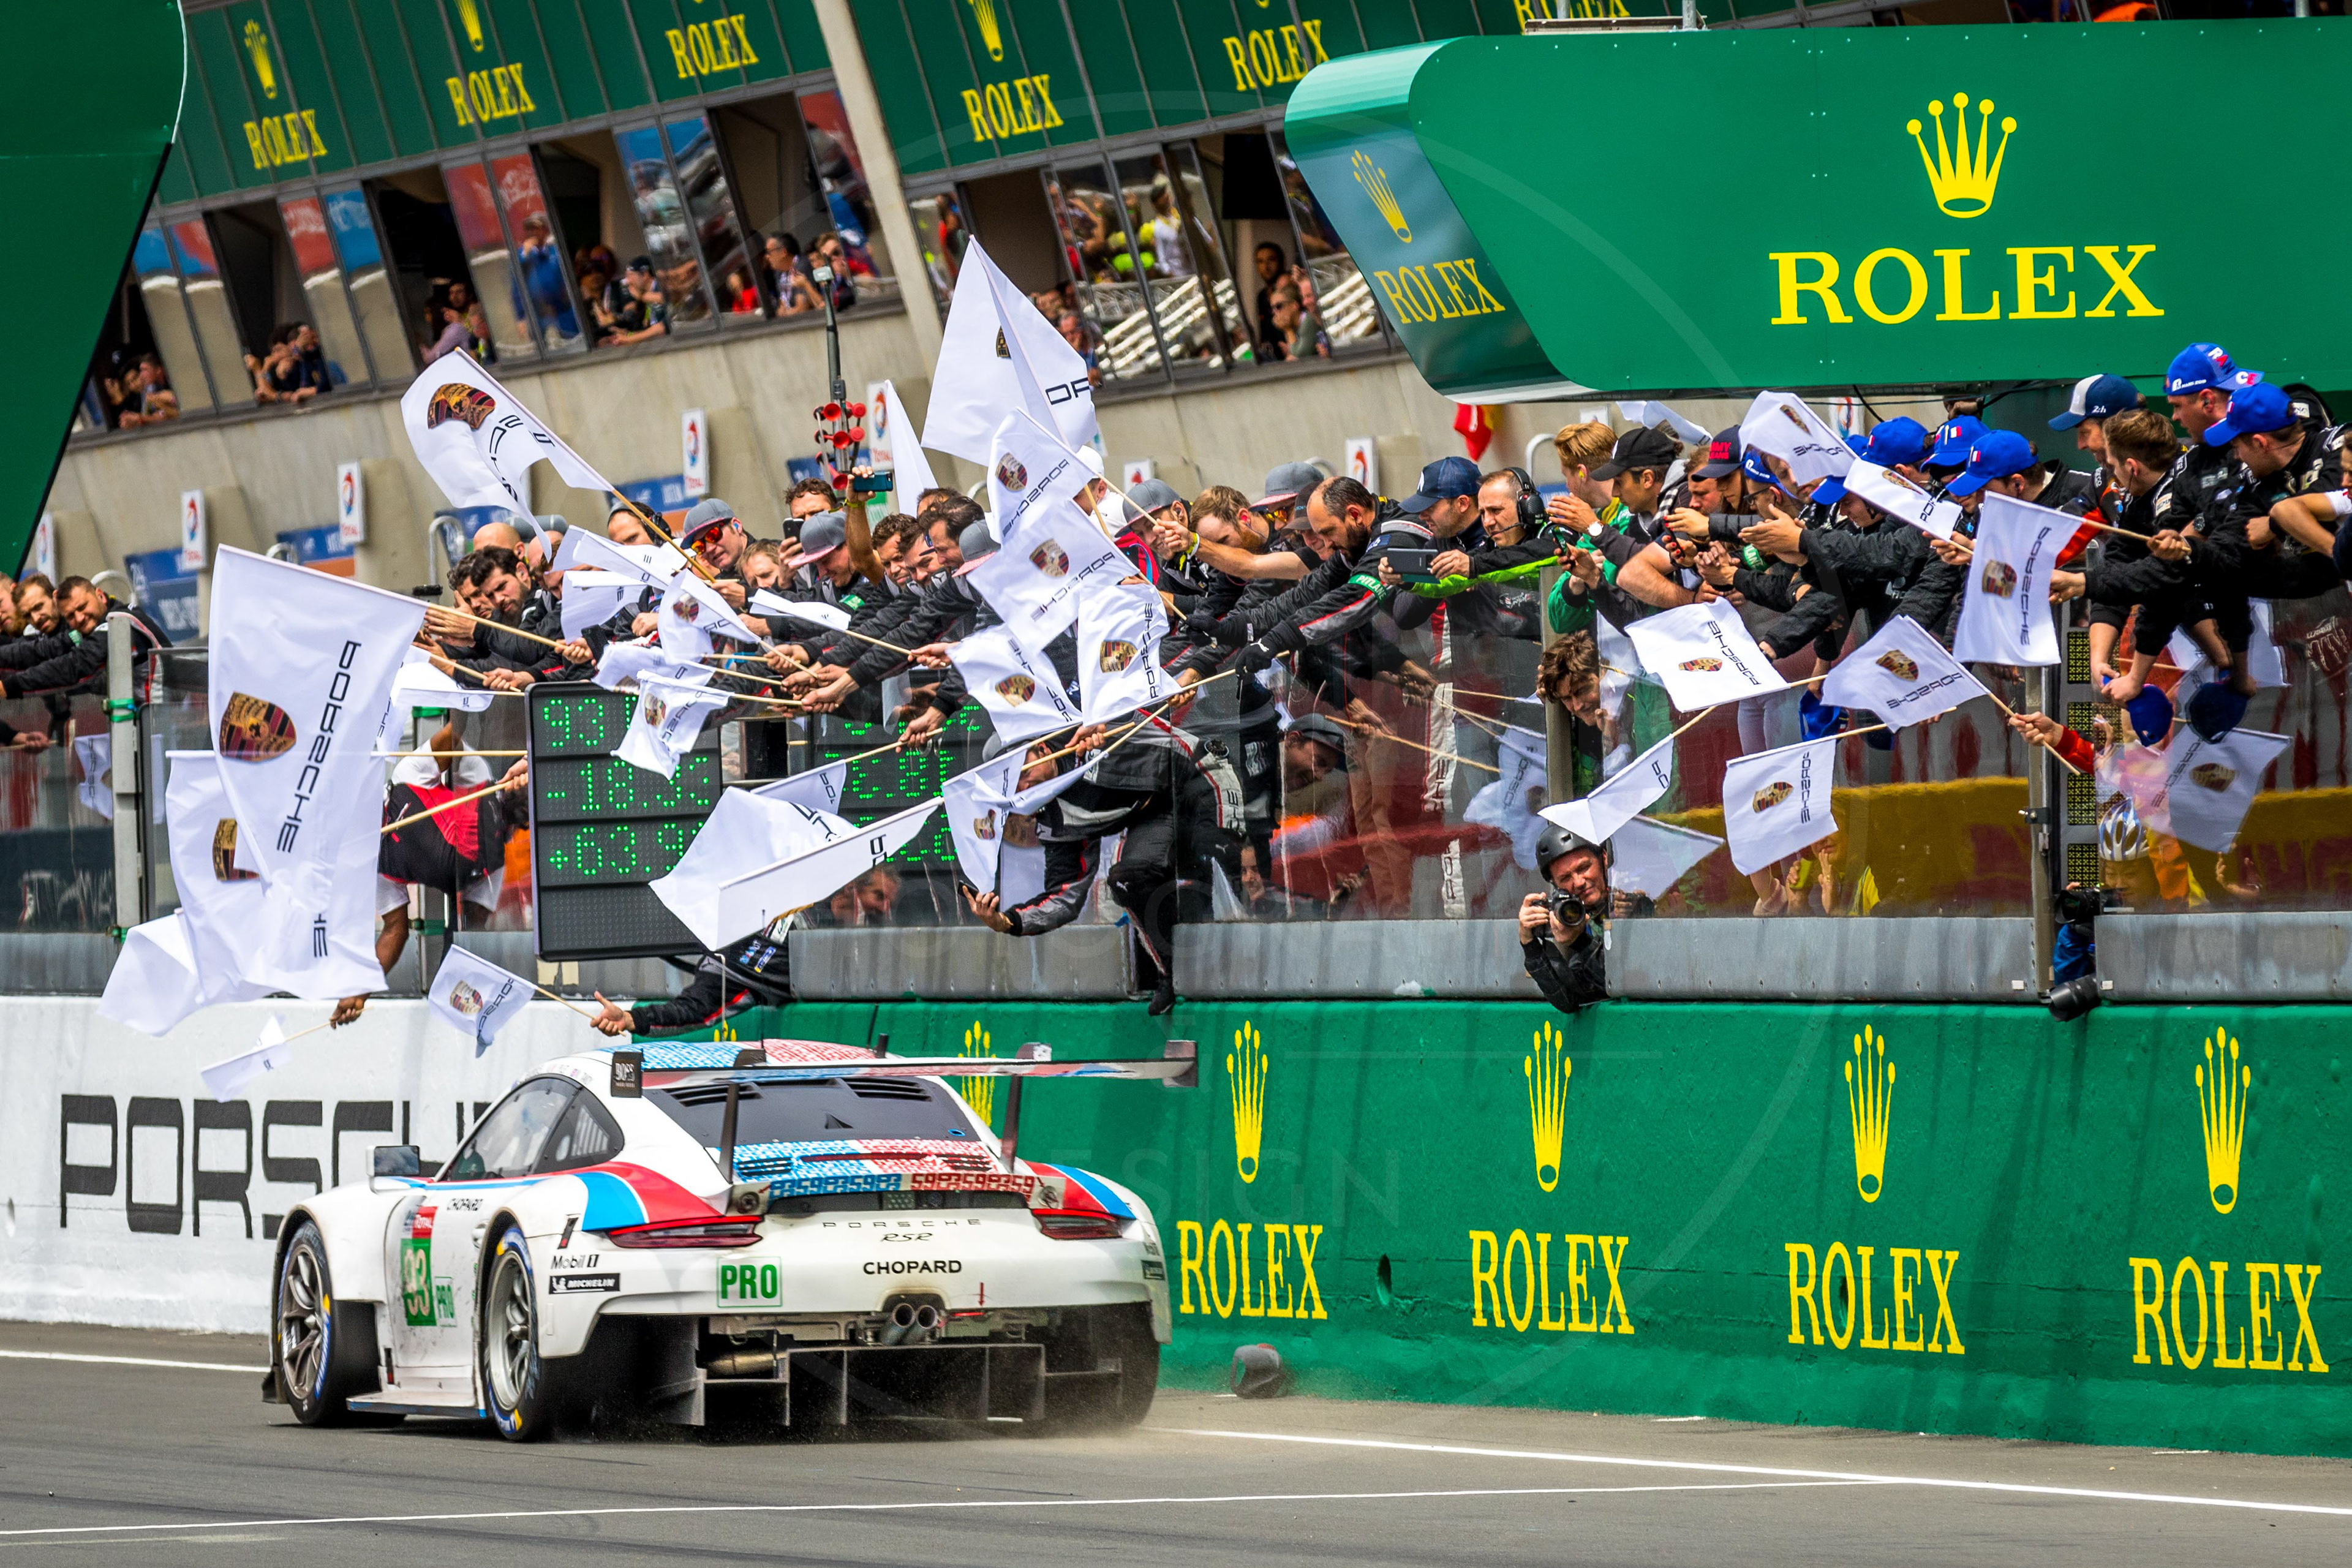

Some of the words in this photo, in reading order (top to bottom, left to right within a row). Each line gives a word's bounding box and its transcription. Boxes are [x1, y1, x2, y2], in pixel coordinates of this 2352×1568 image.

[666, 13, 759, 79] ROLEX
[1223, 19, 1329, 92] ROLEX
[447, 63, 536, 126] ROLEX
[961, 74, 1064, 142] ROLEX
[243, 109, 328, 170] ROLEX
[1374, 258, 1506, 324] ROLEX
[1769, 244, 2165, 325] ROLEX
[1355, 575, 1387, 601] PITLANE
[1708, 619, 1762, 685] PORSCHE
[543, 699, 605, 747] 93
[823, 1219, 981, 1228] PORSCHE
[881, 1232, 933, 1242] RSR
[404, 1248, 429, 1317] 93
[551, 1255, 585, 1270] Mobil
[567, 1278, 615, 1288] MICHELIN
[721, 1264, 778, 1300] PRO
[863, 1259, 962, 1275] CHOPARD
[1177, 1219, 1328, 1319] ROLEX
[1469, 1228, 1635, 1335] ROLEX
[1785, 1242, 1966, 1355] ROLEX
[2128, 1256, 2329, 1373] ROLEX
